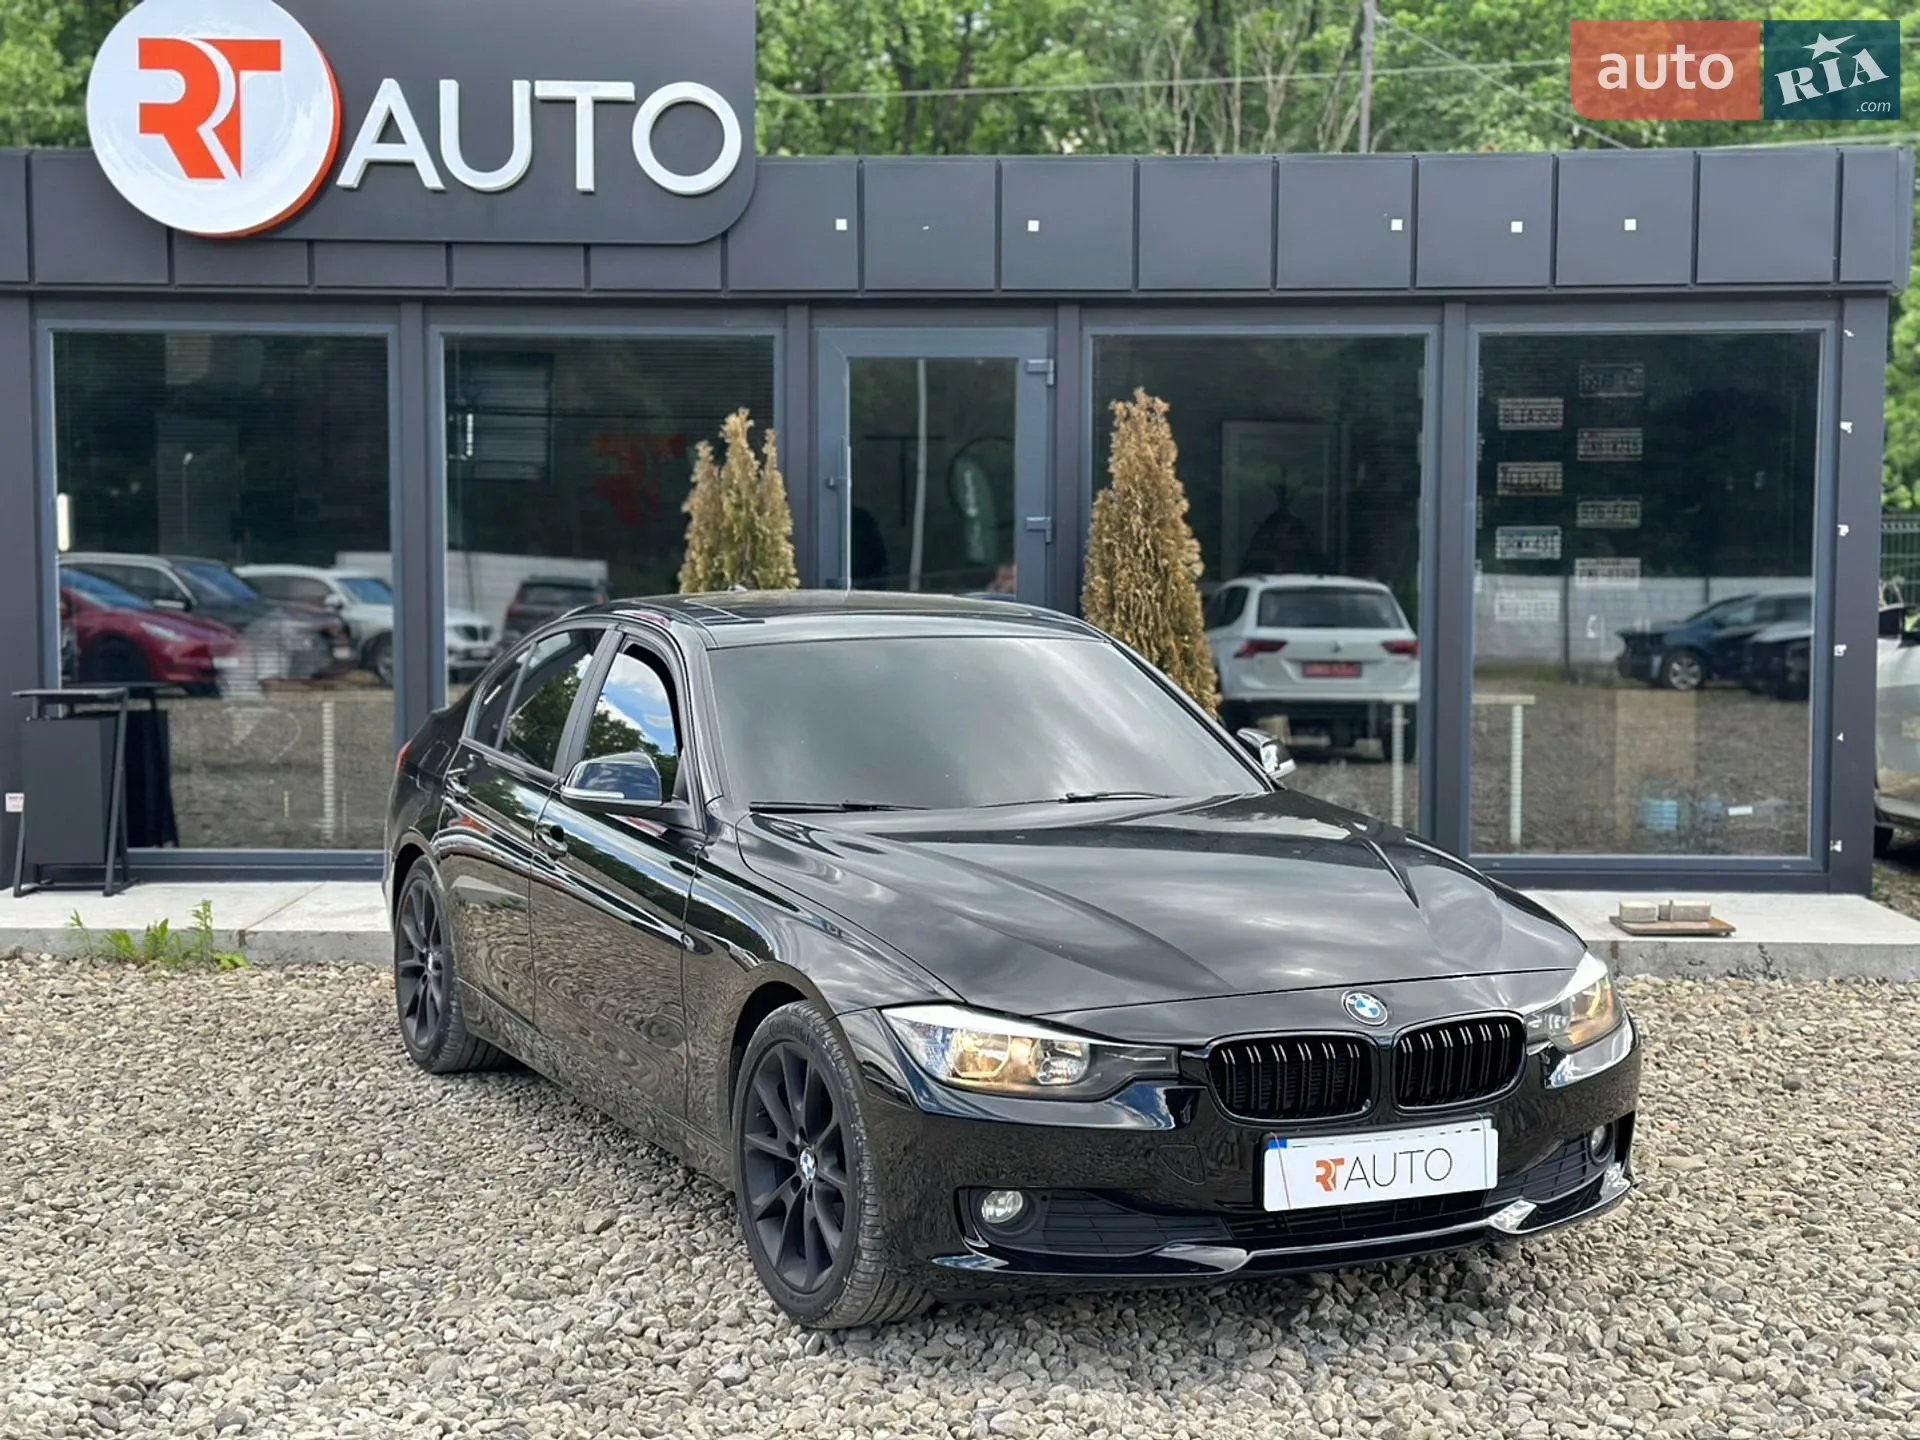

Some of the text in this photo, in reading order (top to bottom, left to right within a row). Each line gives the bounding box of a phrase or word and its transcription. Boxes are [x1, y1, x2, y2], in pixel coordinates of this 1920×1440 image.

[138, 37, 743, 195] RT AUTO
[1344, 1148, 1453, 1191] AUTO
